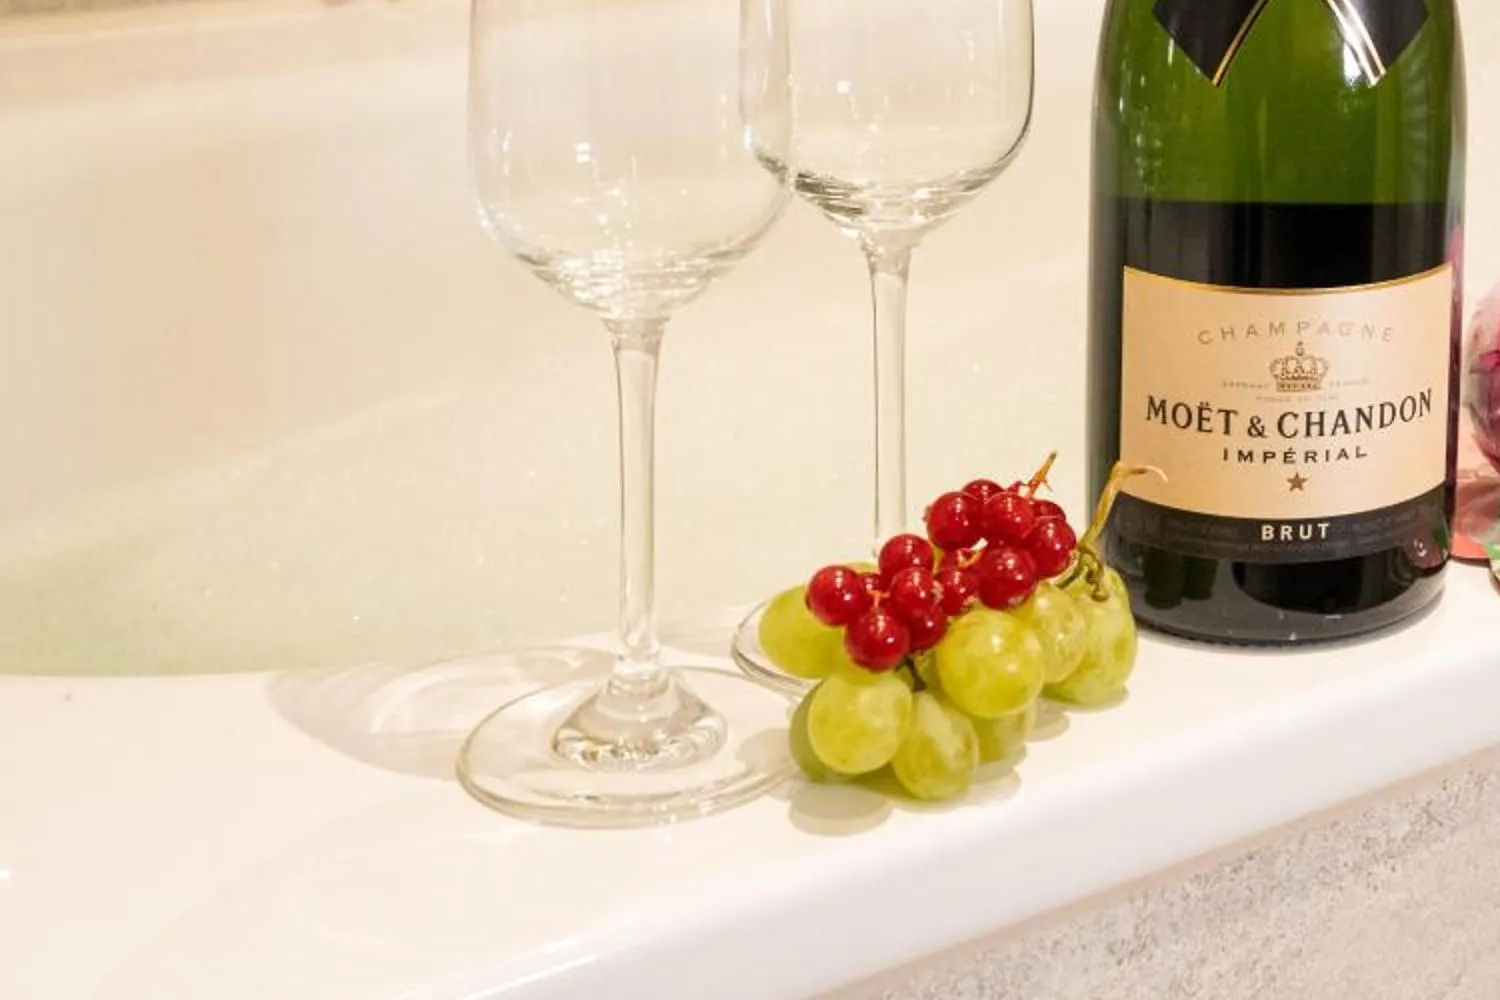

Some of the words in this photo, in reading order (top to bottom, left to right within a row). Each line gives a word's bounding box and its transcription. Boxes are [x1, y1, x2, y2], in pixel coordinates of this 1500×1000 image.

[1197, 320, 1395, 346] CHAMPAGNE
[1147, 394, 1239, 436] MOËT
[1247, 416, 1267, 438] &
[1277, 388, 1432, 439] CHANDON
[1223, 446, 1368, 464] IMPÉRIAL
[1261, 523, 1331, 541] BRUT
